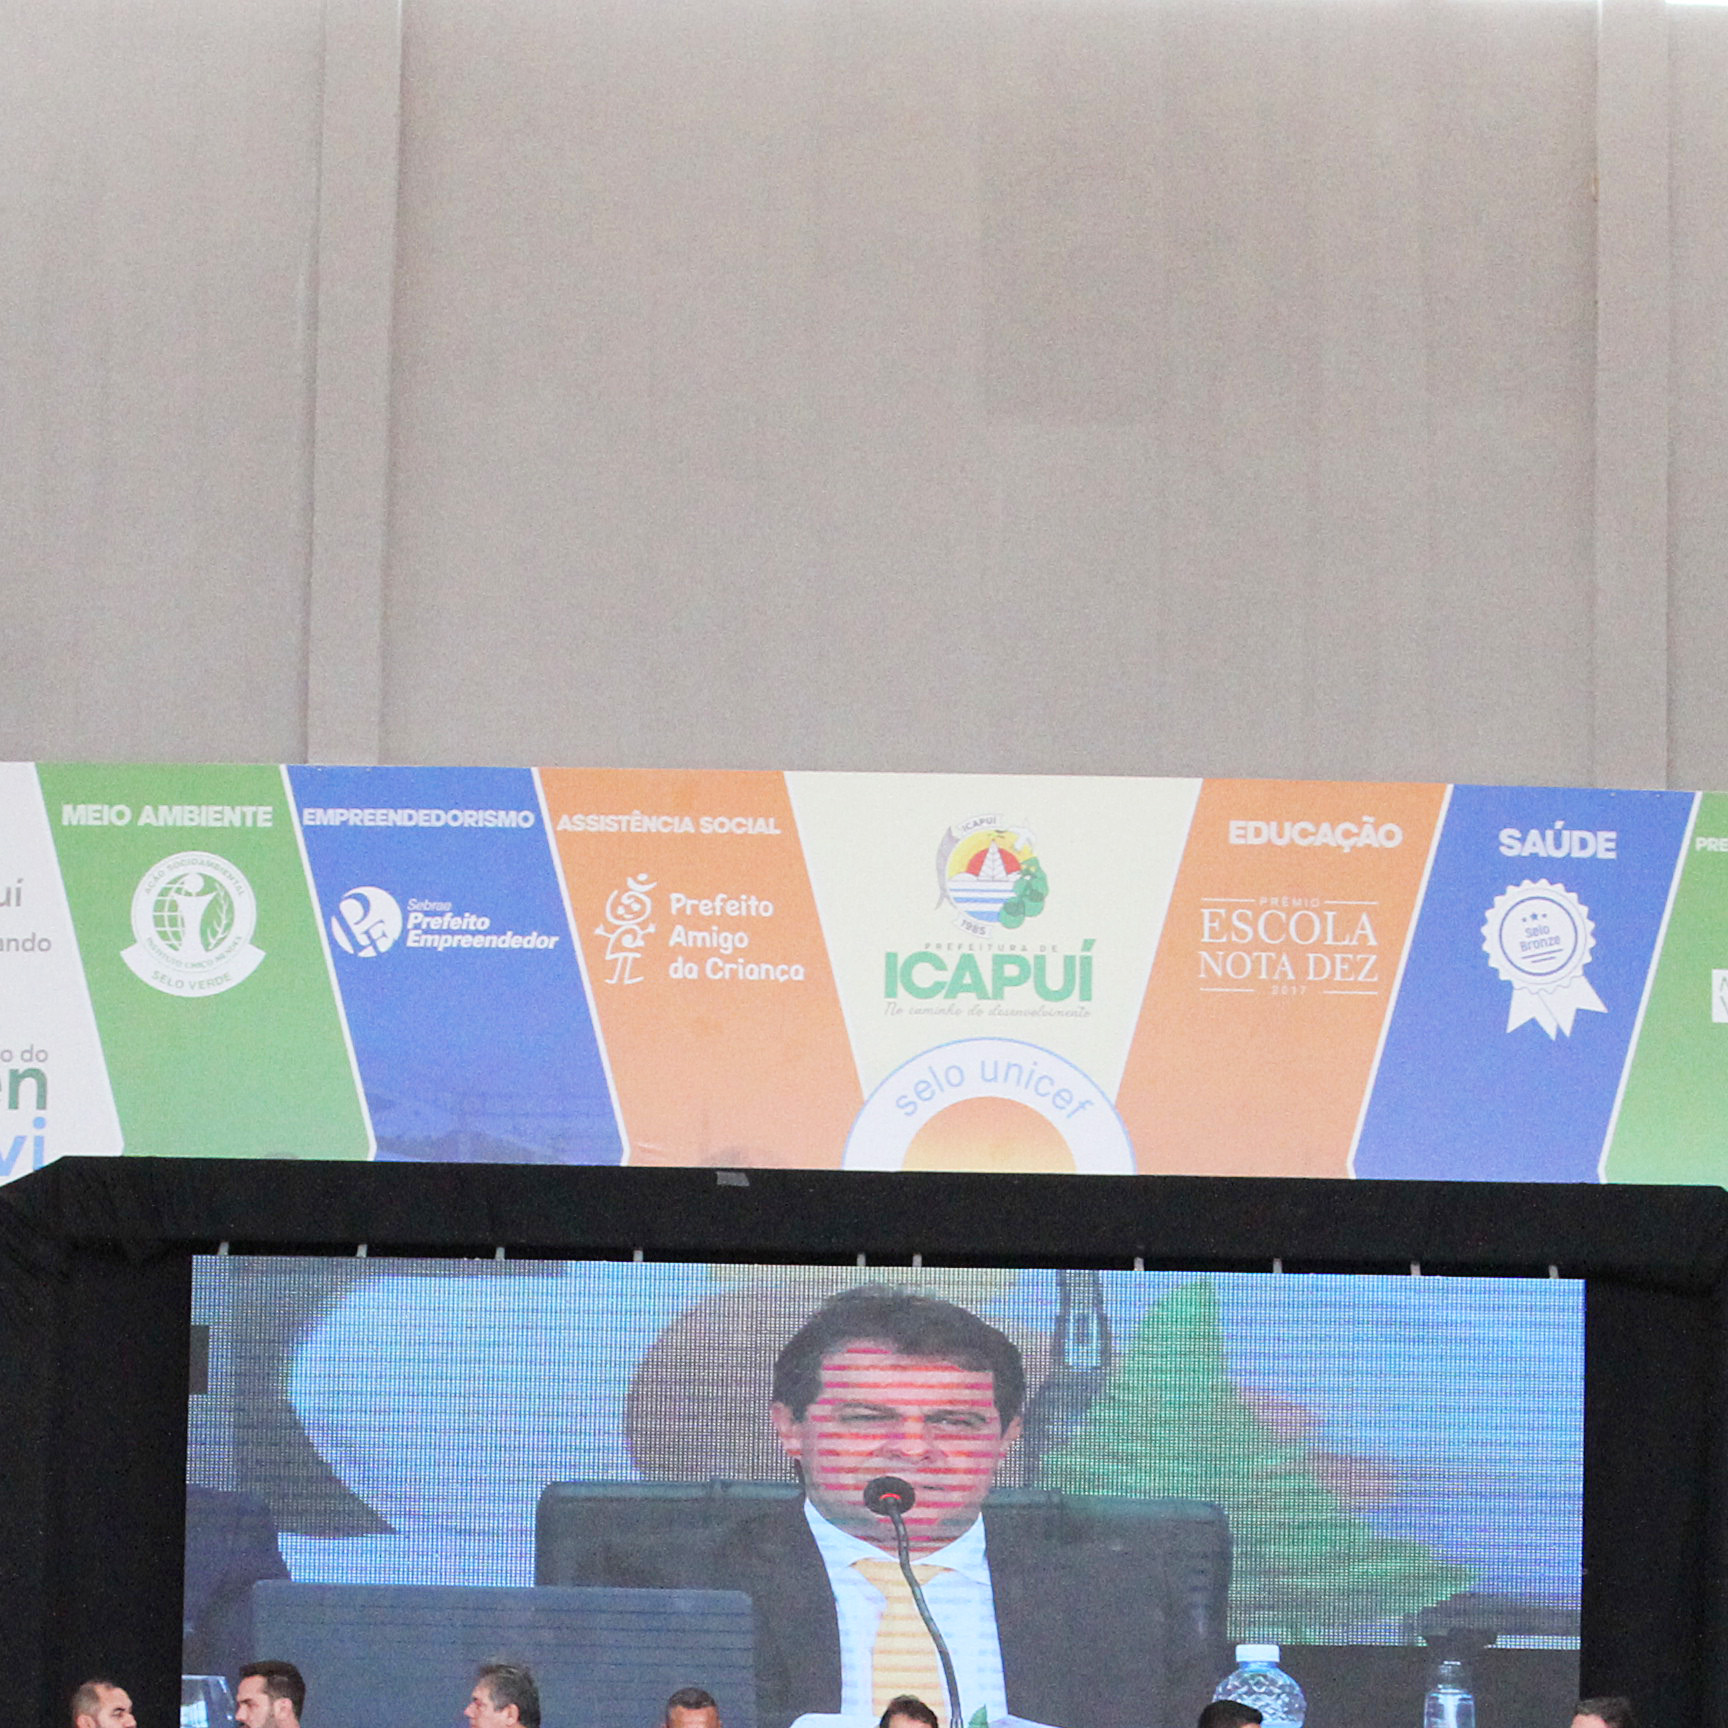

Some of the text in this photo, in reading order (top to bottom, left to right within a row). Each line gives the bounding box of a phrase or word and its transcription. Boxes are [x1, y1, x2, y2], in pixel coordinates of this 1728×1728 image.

[62, 804, 273, 827] MEIO AMBIENTE
[302, 808, 535, 828] EMPREENDEDORISMO
[557, 810, 781, 835] ASSISTÊNCIA SOCIAL
[1228, 815, 1403, 853] EDUCAÇÃO
[1498, 820, 1617, 859] SAÚDE
[407, 898, 452, 911] Sebrae
[669, 893, 774, 917] Prefeito
[407, 912, 490, 930] Prefeito
[1200, 908, 1378, 946] ESCOLA
[1525, 925, 1550, 938] Selo
[406, 930, 559, 951] Empreendedor
[669, 924, 749, 955] Amigo
[924, 942, 1058, 953] PREFEITURA DE
[1520, 935, 1561, 951] Bronze
[669, 956, 804, 983] da Criança
[884, 938, 1096, 1002] ICAPUÍ
[1198, 952, 1378, 982] NOTA DEZ
[151, 970, 232, 990] SELO VERDE
[21, 1045, 48, 1063] do
[896, 1060, 1094, 1119] selo unicef
